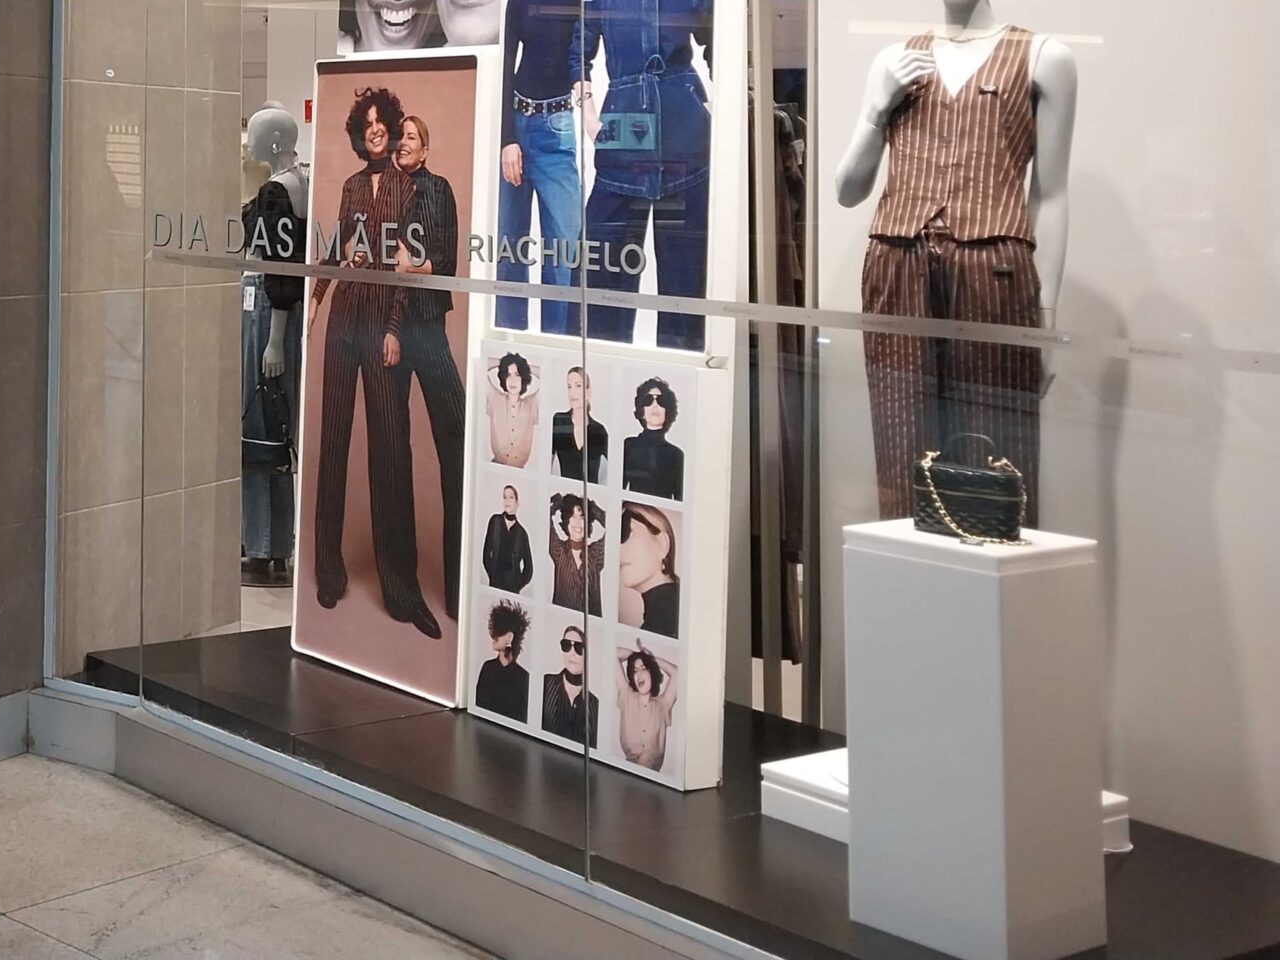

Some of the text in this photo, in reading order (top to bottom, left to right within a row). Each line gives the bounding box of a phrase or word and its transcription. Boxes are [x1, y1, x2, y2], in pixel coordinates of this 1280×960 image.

[153, 212, 426, 268] DIA DAS MÃES
[467, 233, 647, 276] RIACHUELO
